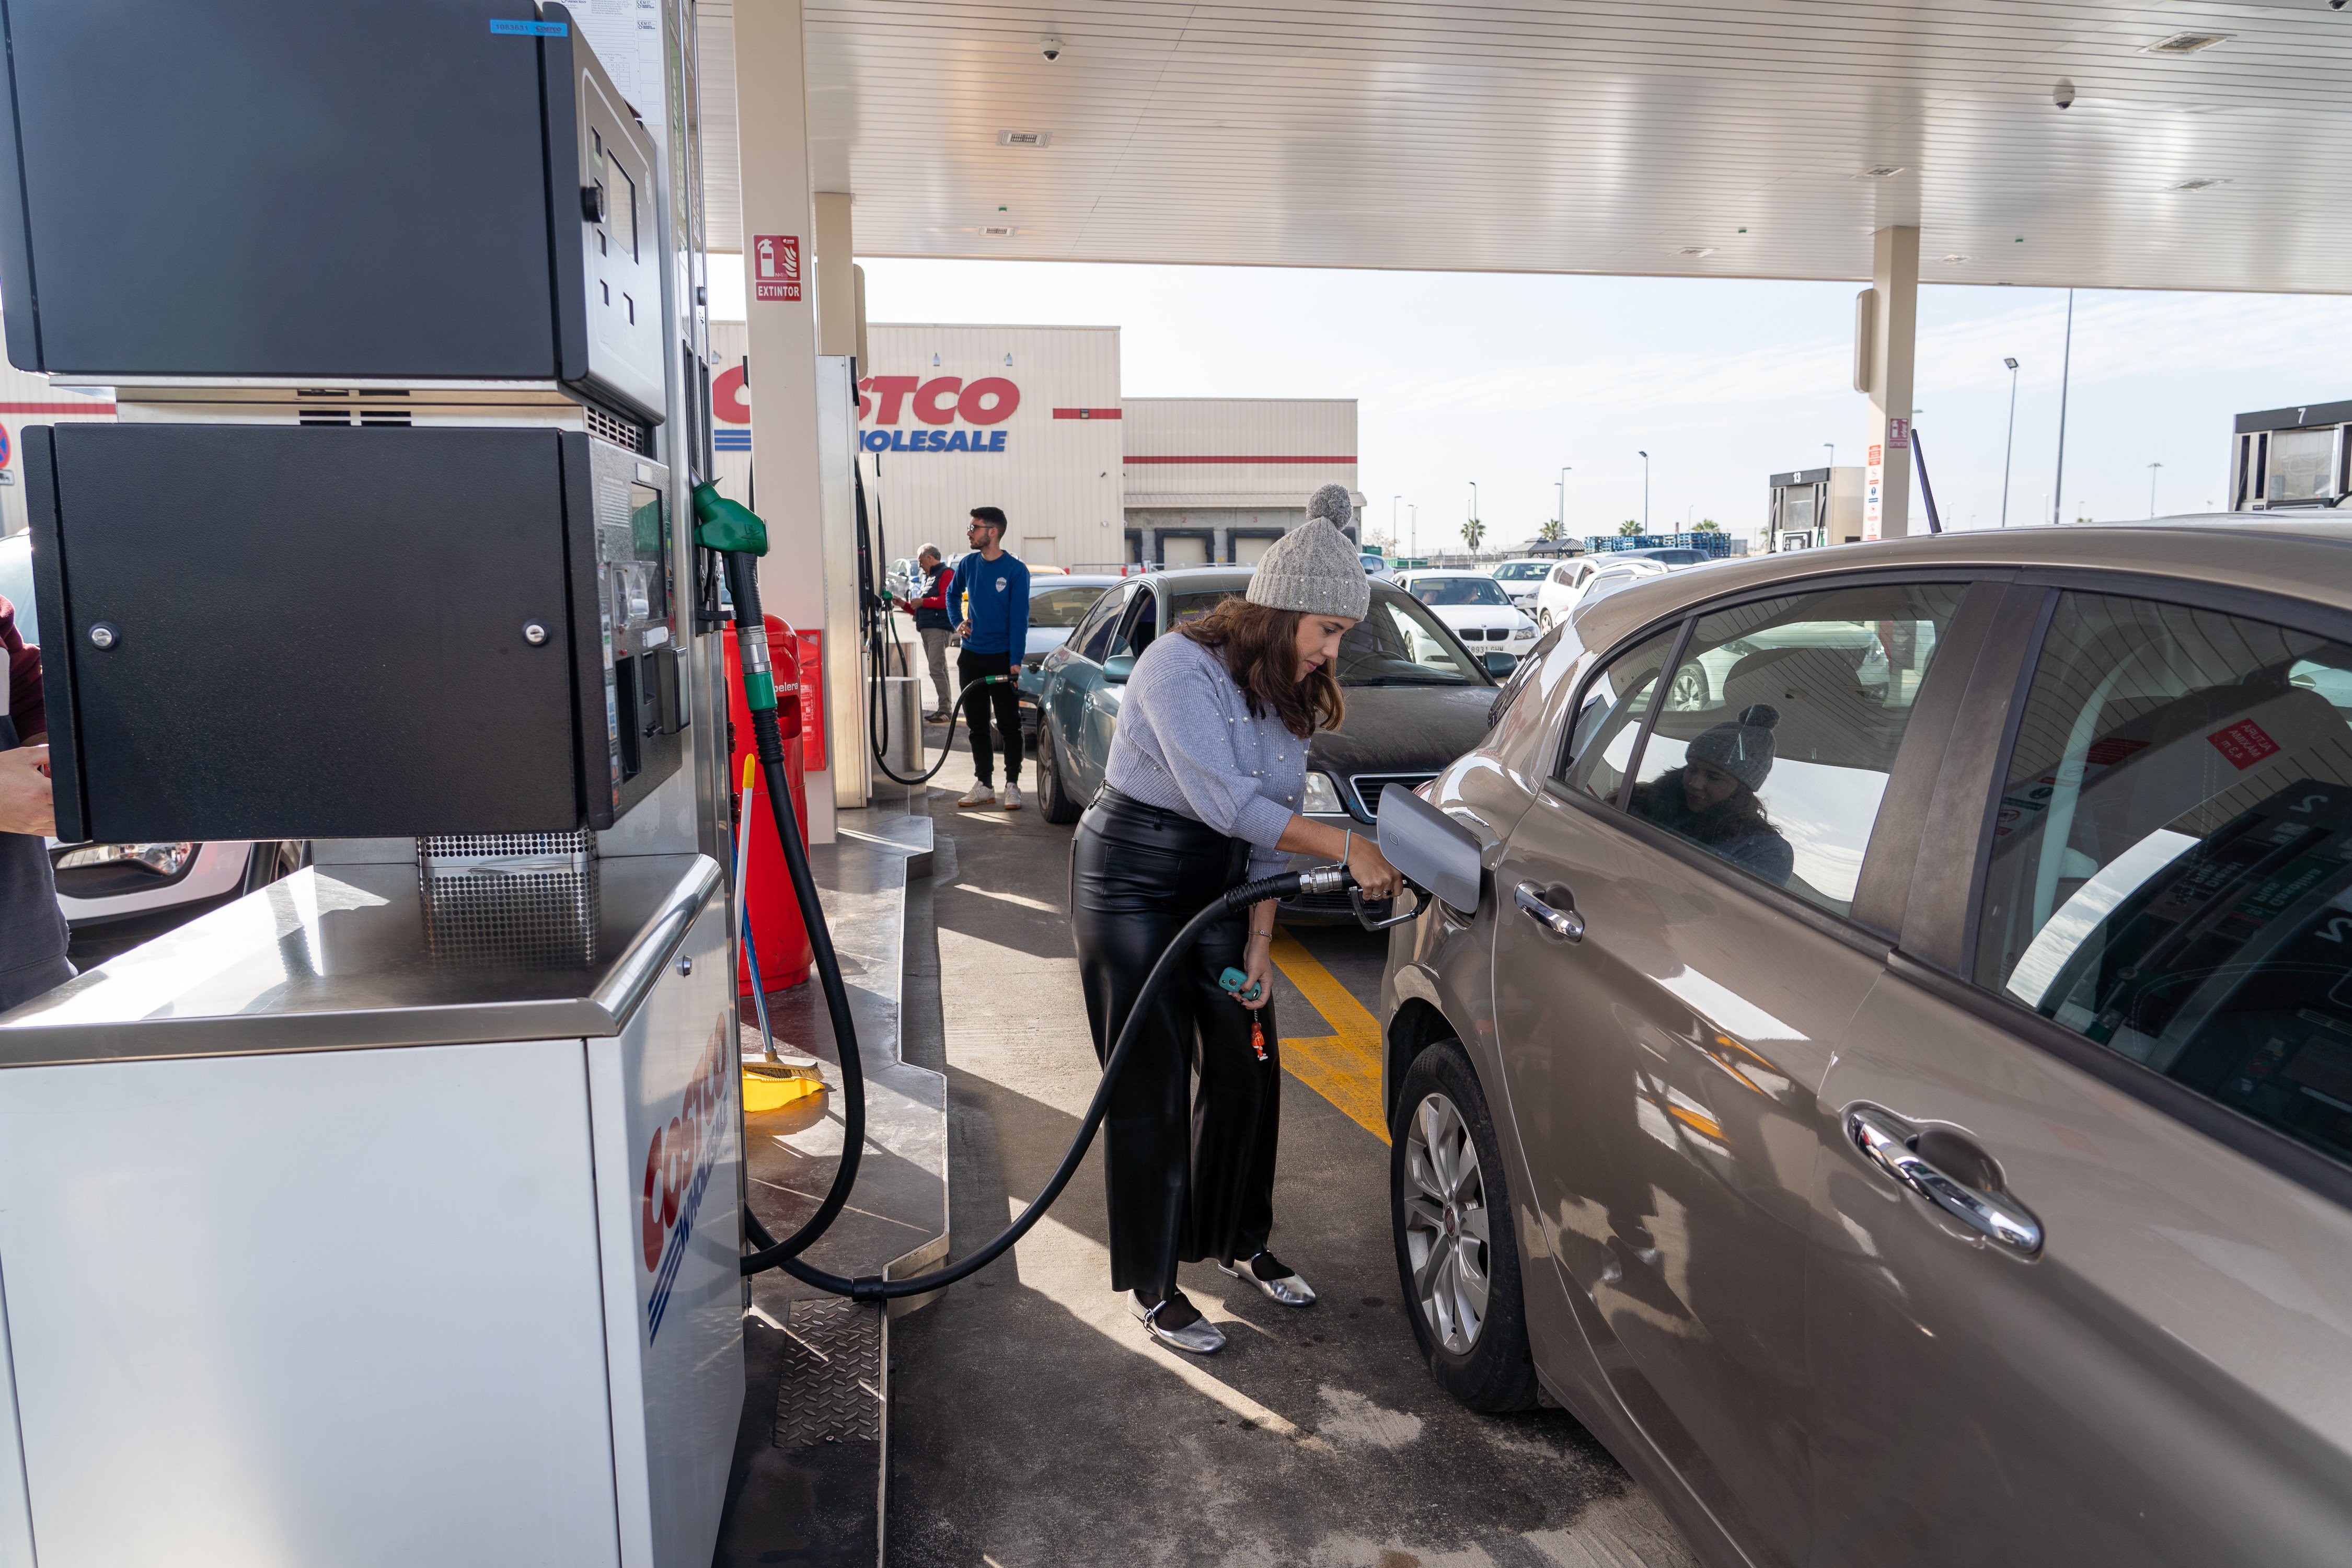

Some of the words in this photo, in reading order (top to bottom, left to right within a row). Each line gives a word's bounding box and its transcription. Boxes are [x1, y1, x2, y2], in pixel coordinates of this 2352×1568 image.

[758, 285, 800, 297] EXTINTOR
[712, 365, 1020, 425] CTCO
[2298, 408, 2305, 424] 7
[860, 430, 1007, 453] OLESALE
[1793, 472, 1801, 483] 13
[775, 682, 798, 693] pelera
[642, 1012, 727, 1273] COSTCO
[678, 1090, 728, 1255] WHOLESALE
